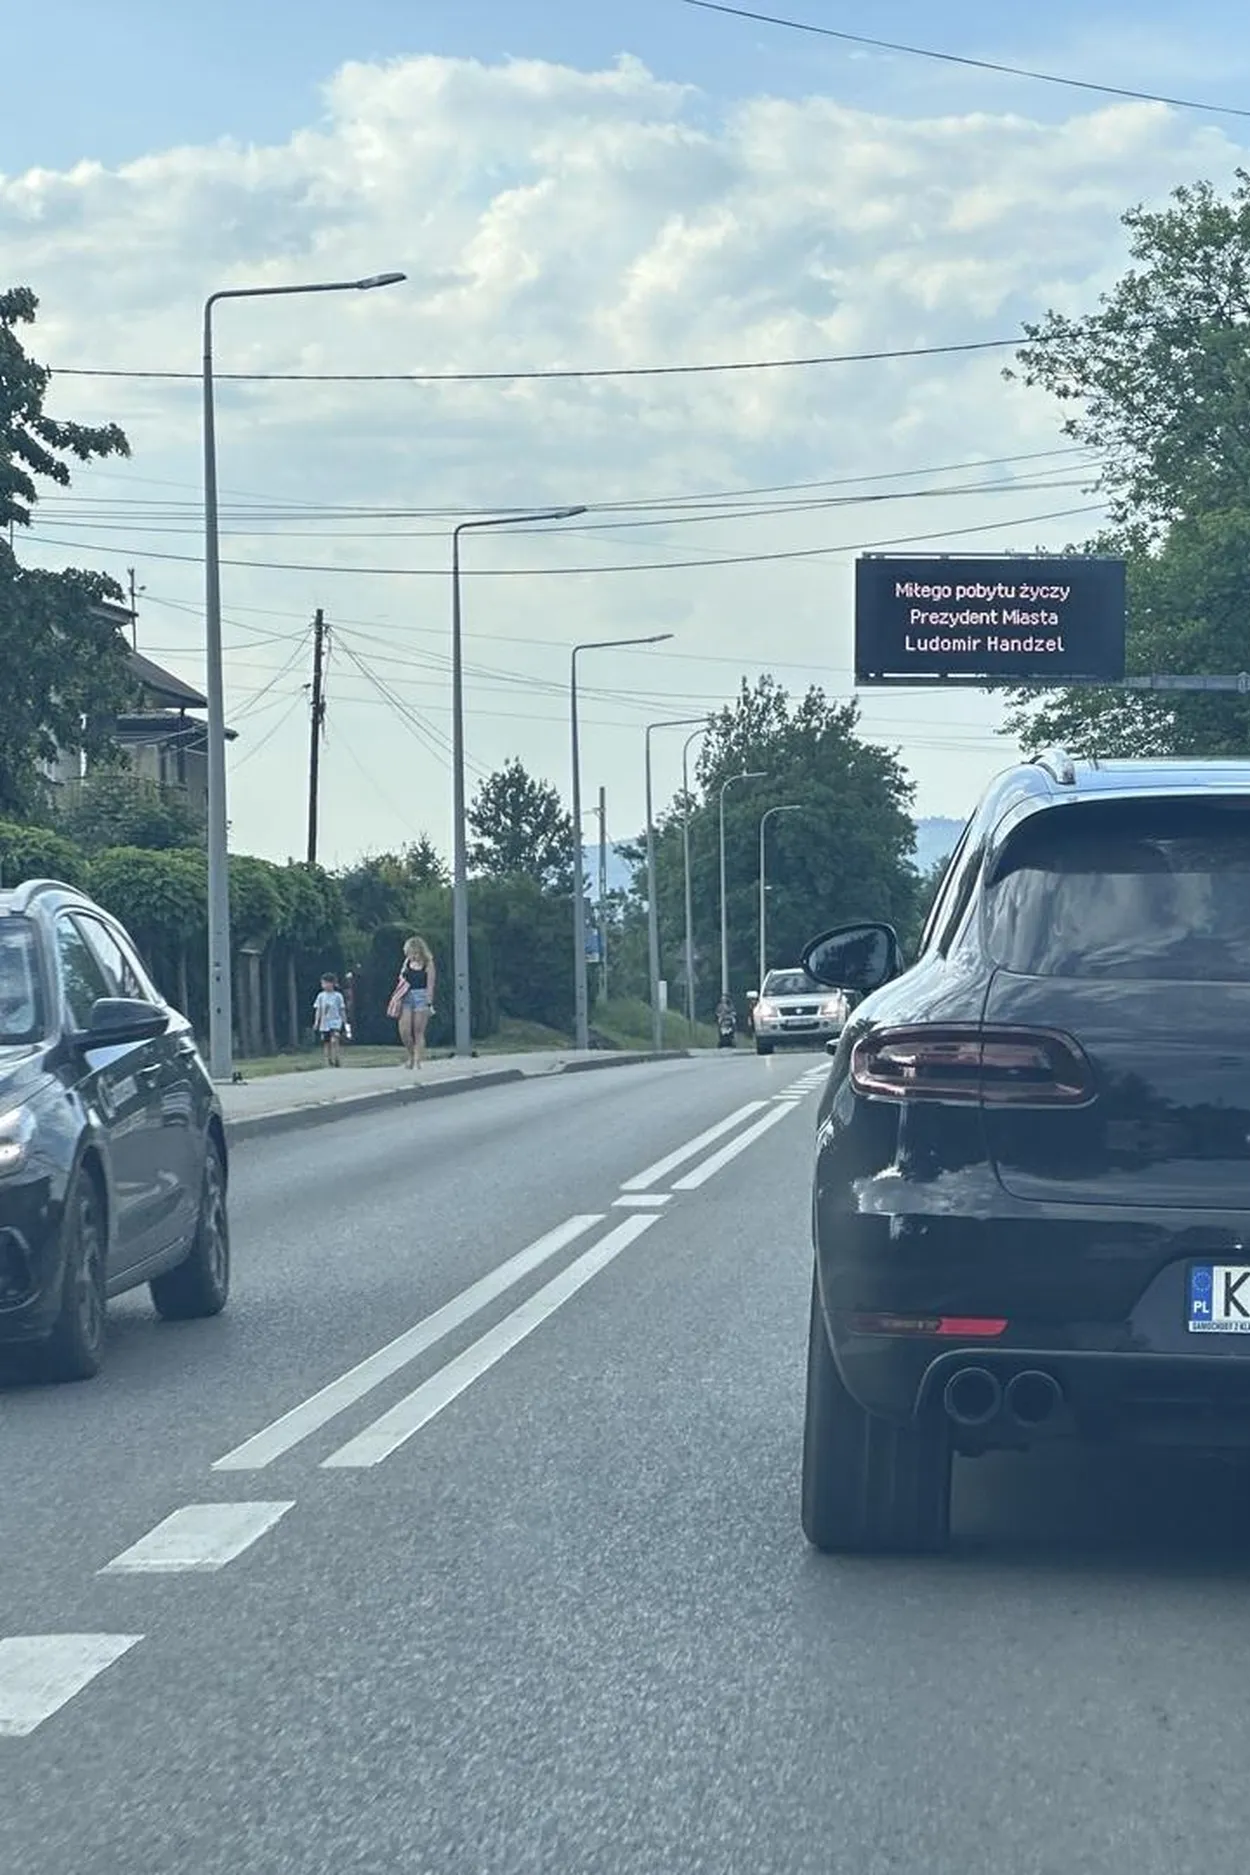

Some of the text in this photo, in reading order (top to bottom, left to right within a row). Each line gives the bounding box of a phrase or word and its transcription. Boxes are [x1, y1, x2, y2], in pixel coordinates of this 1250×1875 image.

[895, 581, 1071, 601] Miłego pobytu życzy
[910, 608, 1059, 628] Prezydent Miasta
[905, 635, 1065, 652] Ludomir Handzel
[1193, 1301, 1210, 1314] PL
